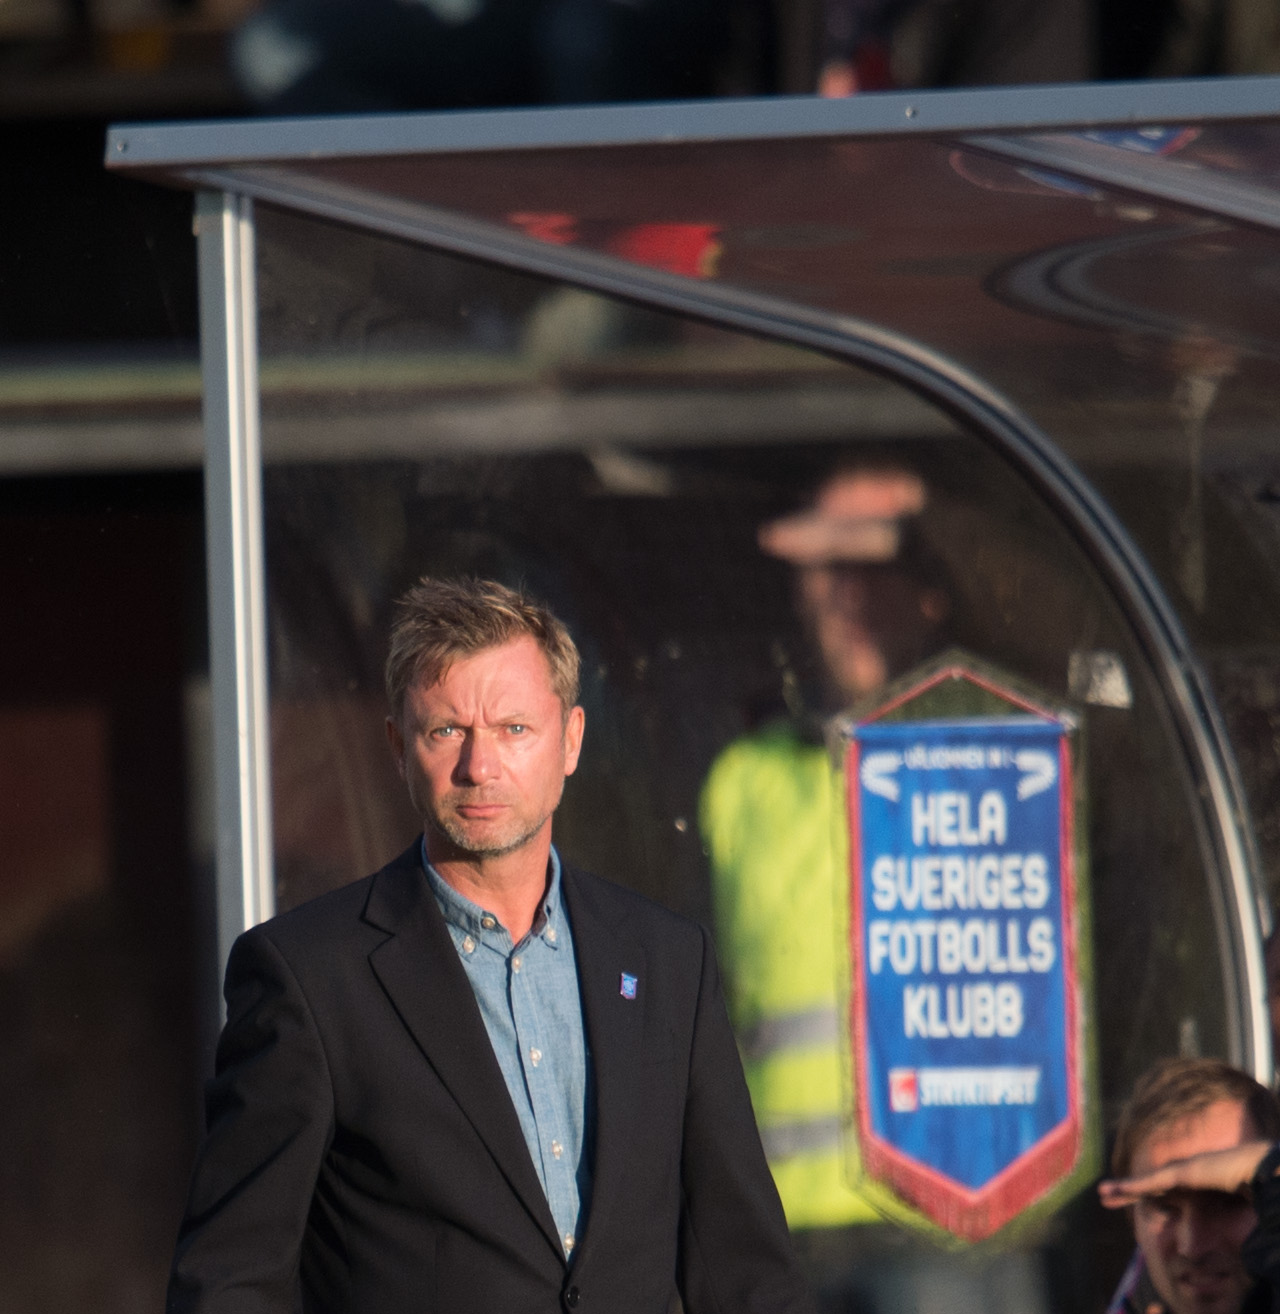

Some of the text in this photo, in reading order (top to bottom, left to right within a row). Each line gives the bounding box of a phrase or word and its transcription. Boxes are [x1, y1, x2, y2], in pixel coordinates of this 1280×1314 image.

[911, 791, 1007, 846] HELA
[871, 853, 1050, 911] SVERIGES
[868, 917, 1056, 975] FOTBOLLS
[903, 983, 1024, 1038] KLUBB
